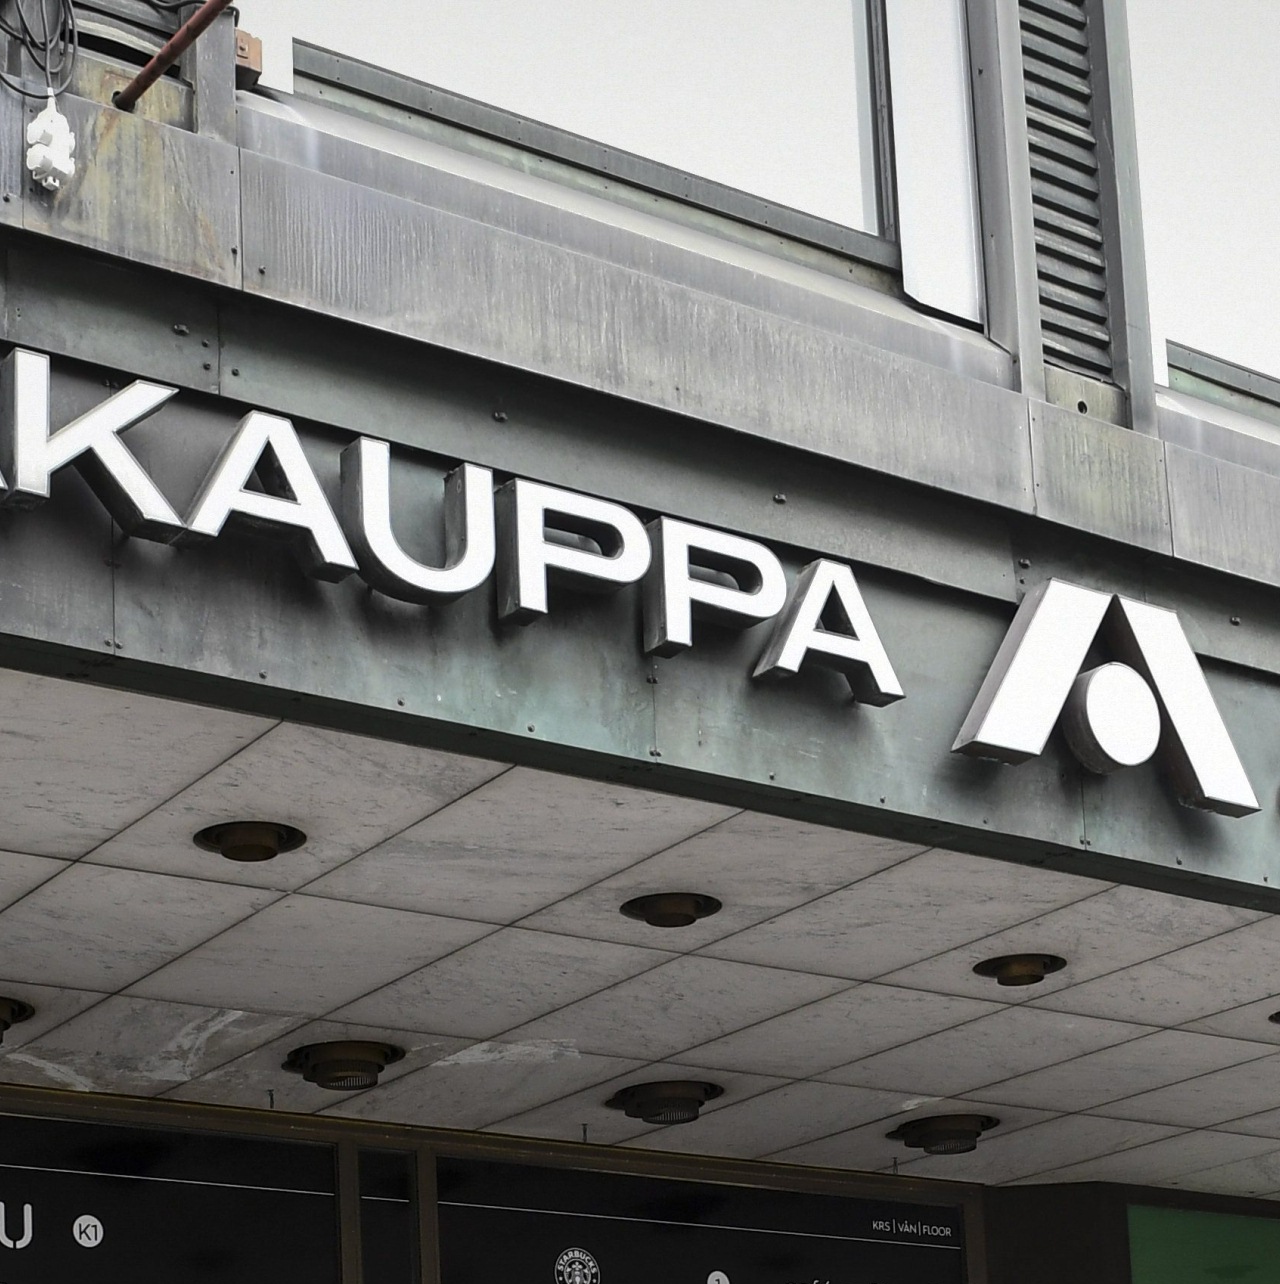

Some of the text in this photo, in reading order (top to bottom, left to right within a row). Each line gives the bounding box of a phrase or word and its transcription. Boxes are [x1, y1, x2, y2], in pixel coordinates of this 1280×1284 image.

[78, 1222, 99, 1243] K1
[922, 1224, 952, 1237] FLOOR
[557, 1250, 598, 1274] STARBUCKS
